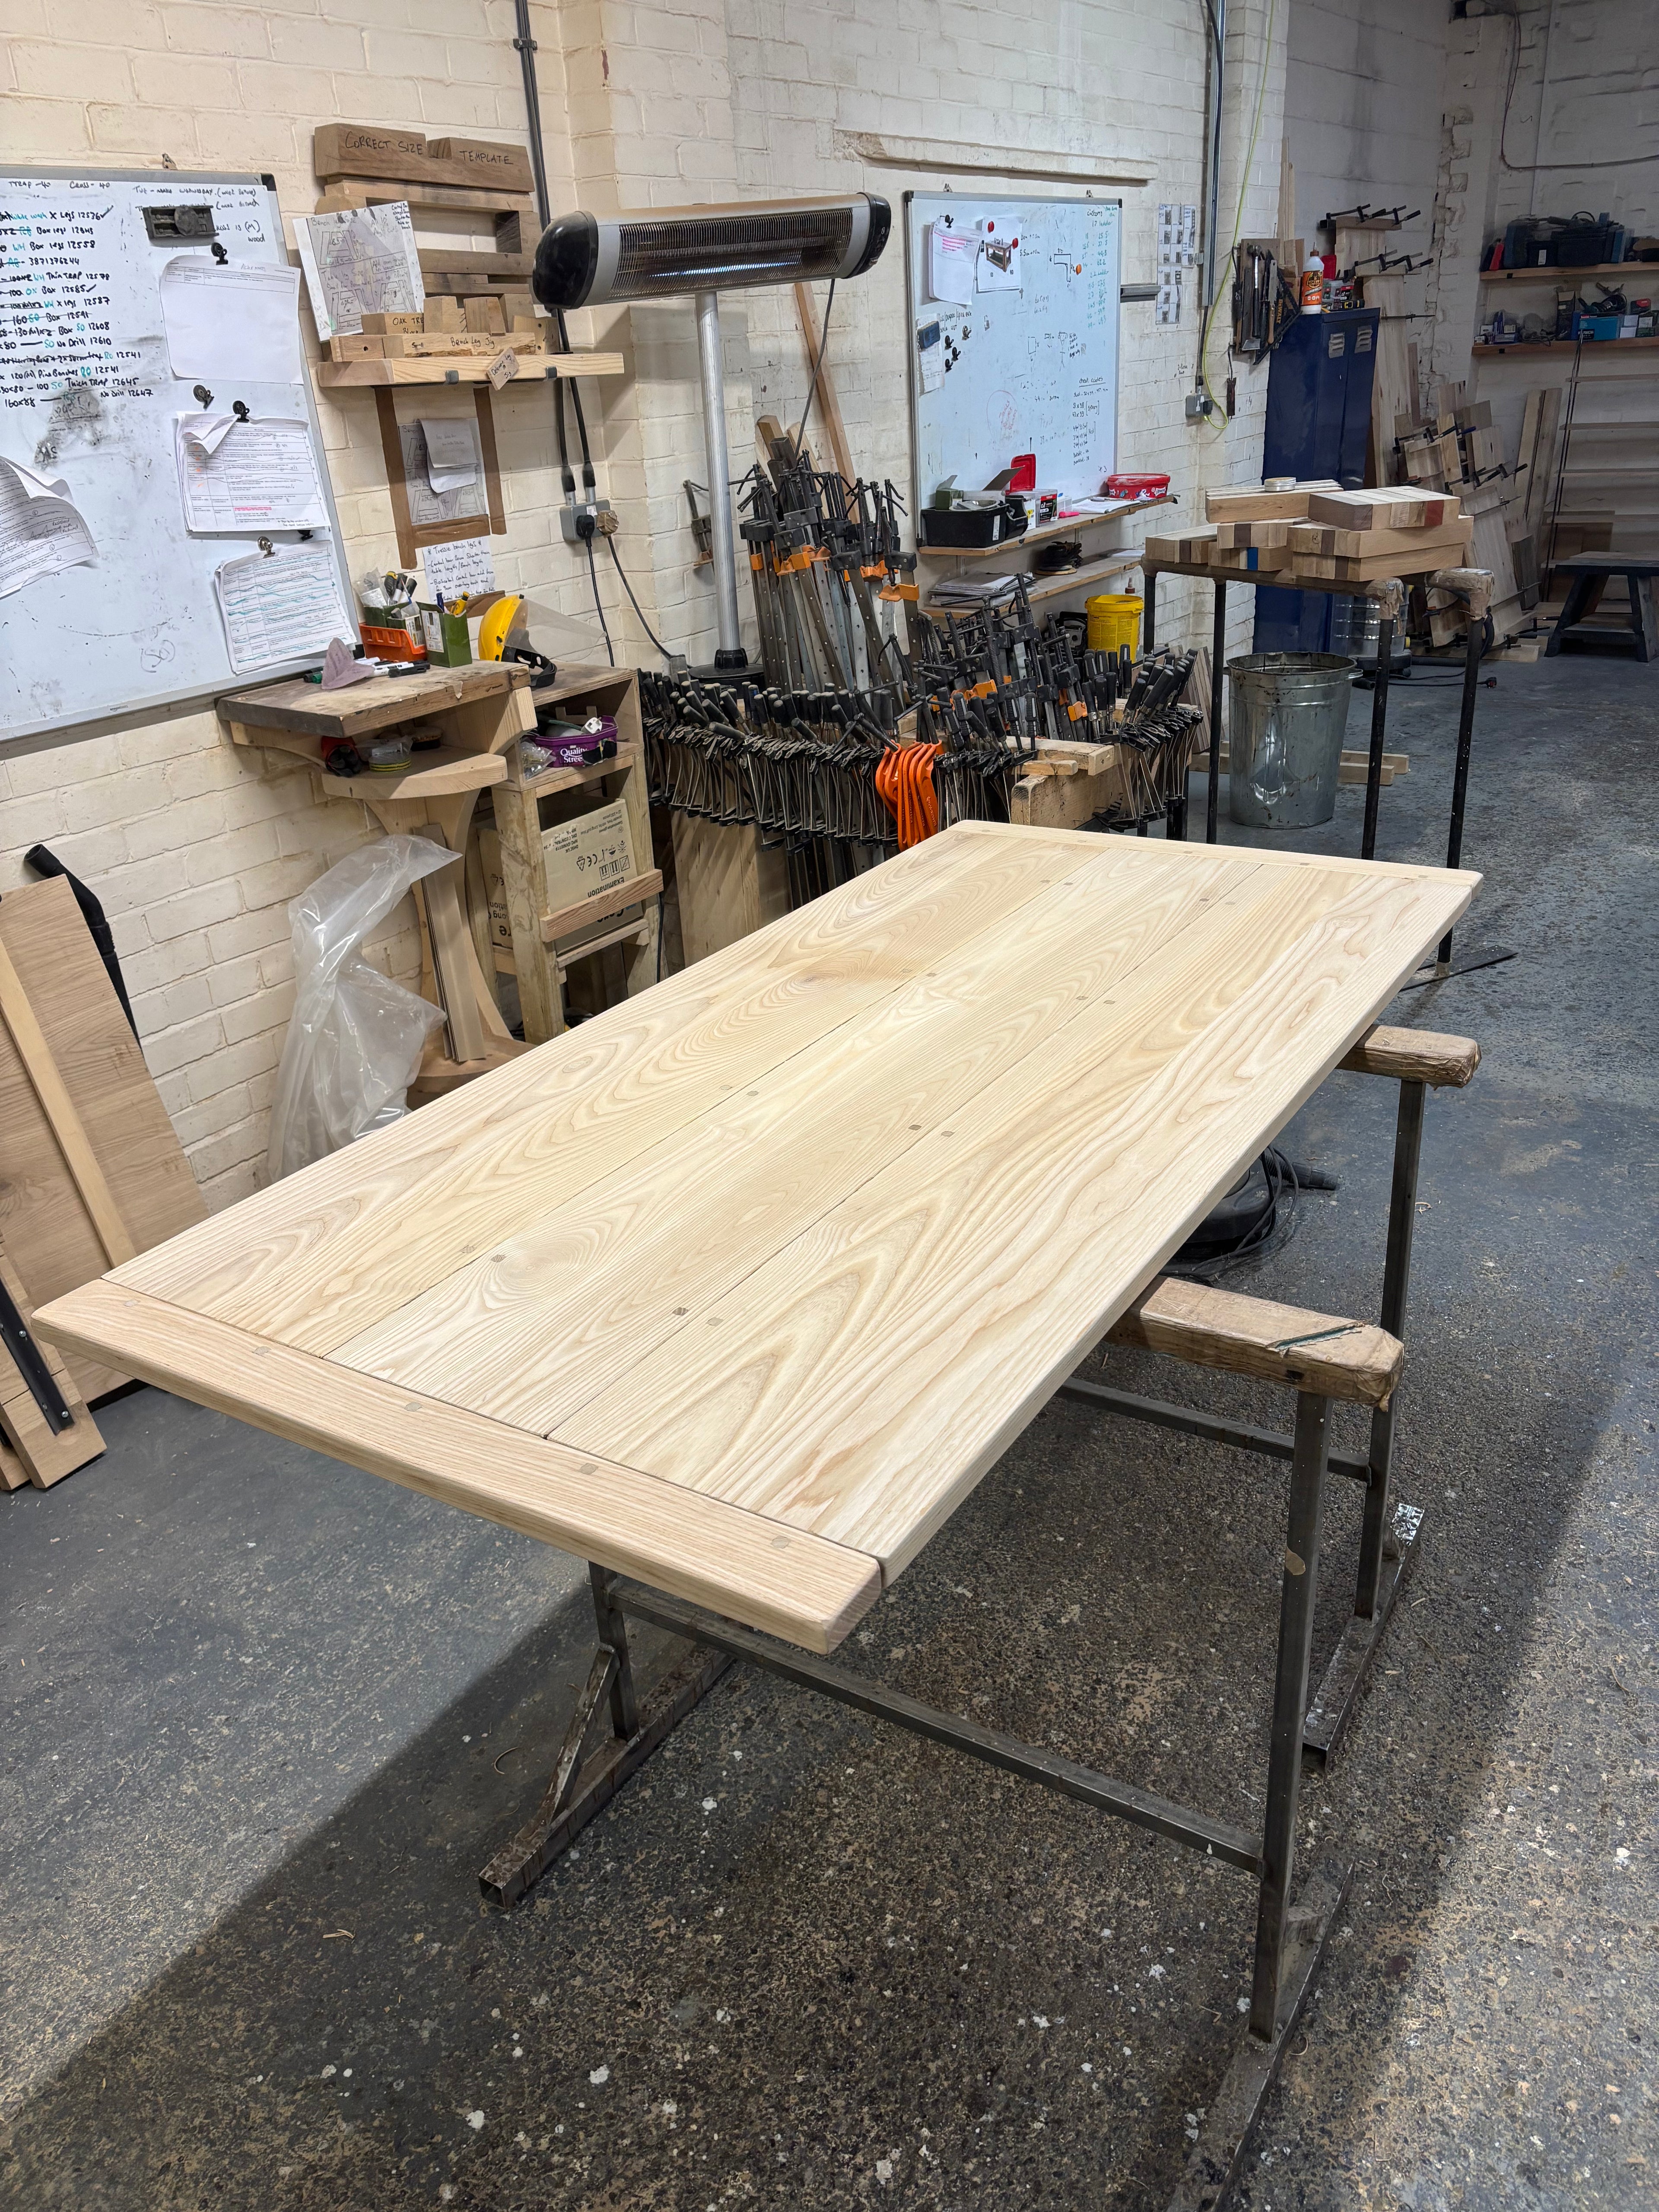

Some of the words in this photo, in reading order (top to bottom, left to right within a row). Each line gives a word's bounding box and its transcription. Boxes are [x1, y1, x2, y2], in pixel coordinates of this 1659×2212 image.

[346, 131, 390, 149] CORRECT
[398, 141, 423, 155] SIZE
[460, 150, 514, 165] TEMPLATE
[450, 337, 469, 346] Bench
[471, 336, 481, 347] Leg
[485, 337, 495, 349] Jig
[588, 877, 625, 898] Examination
